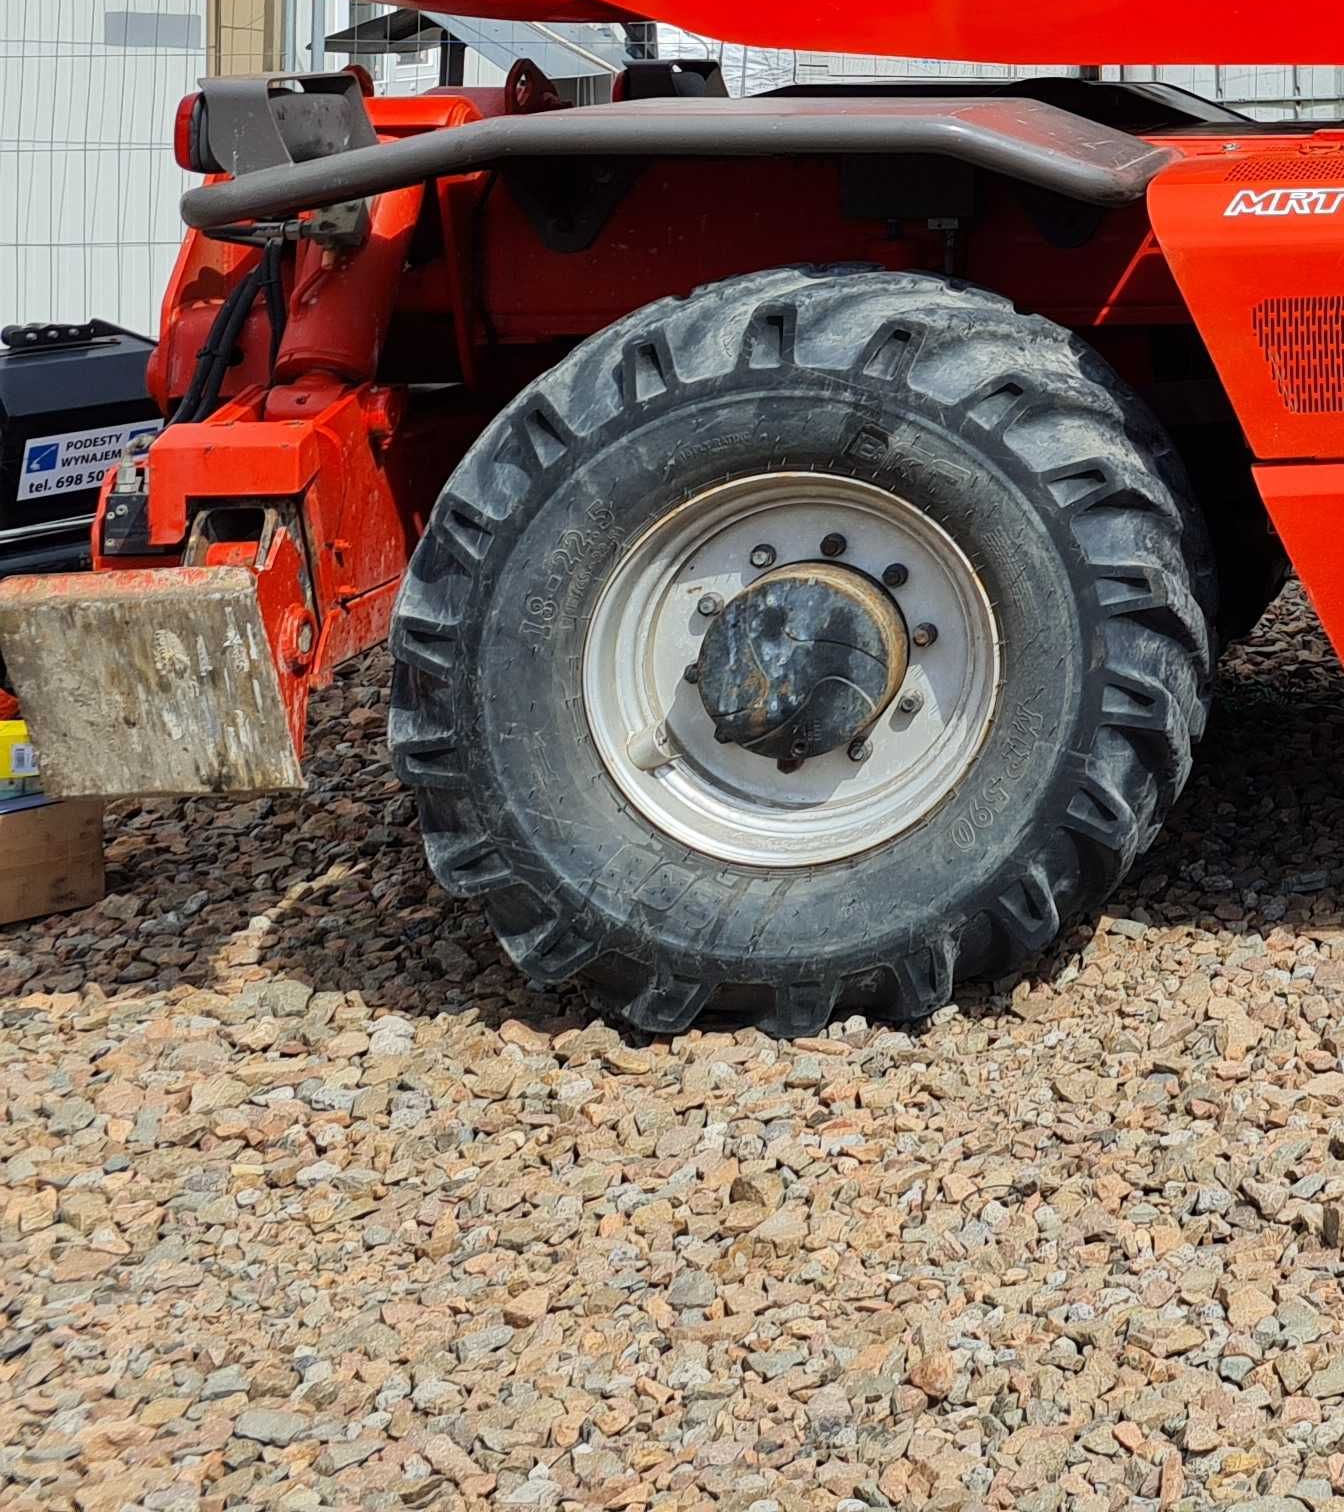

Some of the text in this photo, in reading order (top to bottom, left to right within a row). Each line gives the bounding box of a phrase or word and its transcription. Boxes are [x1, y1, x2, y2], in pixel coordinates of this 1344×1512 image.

[65, 432, 122, 451] PODESTY
[61, 448, 122, 467] WYNAJEM
[28, 468, 109, 494] tel. 698 50
